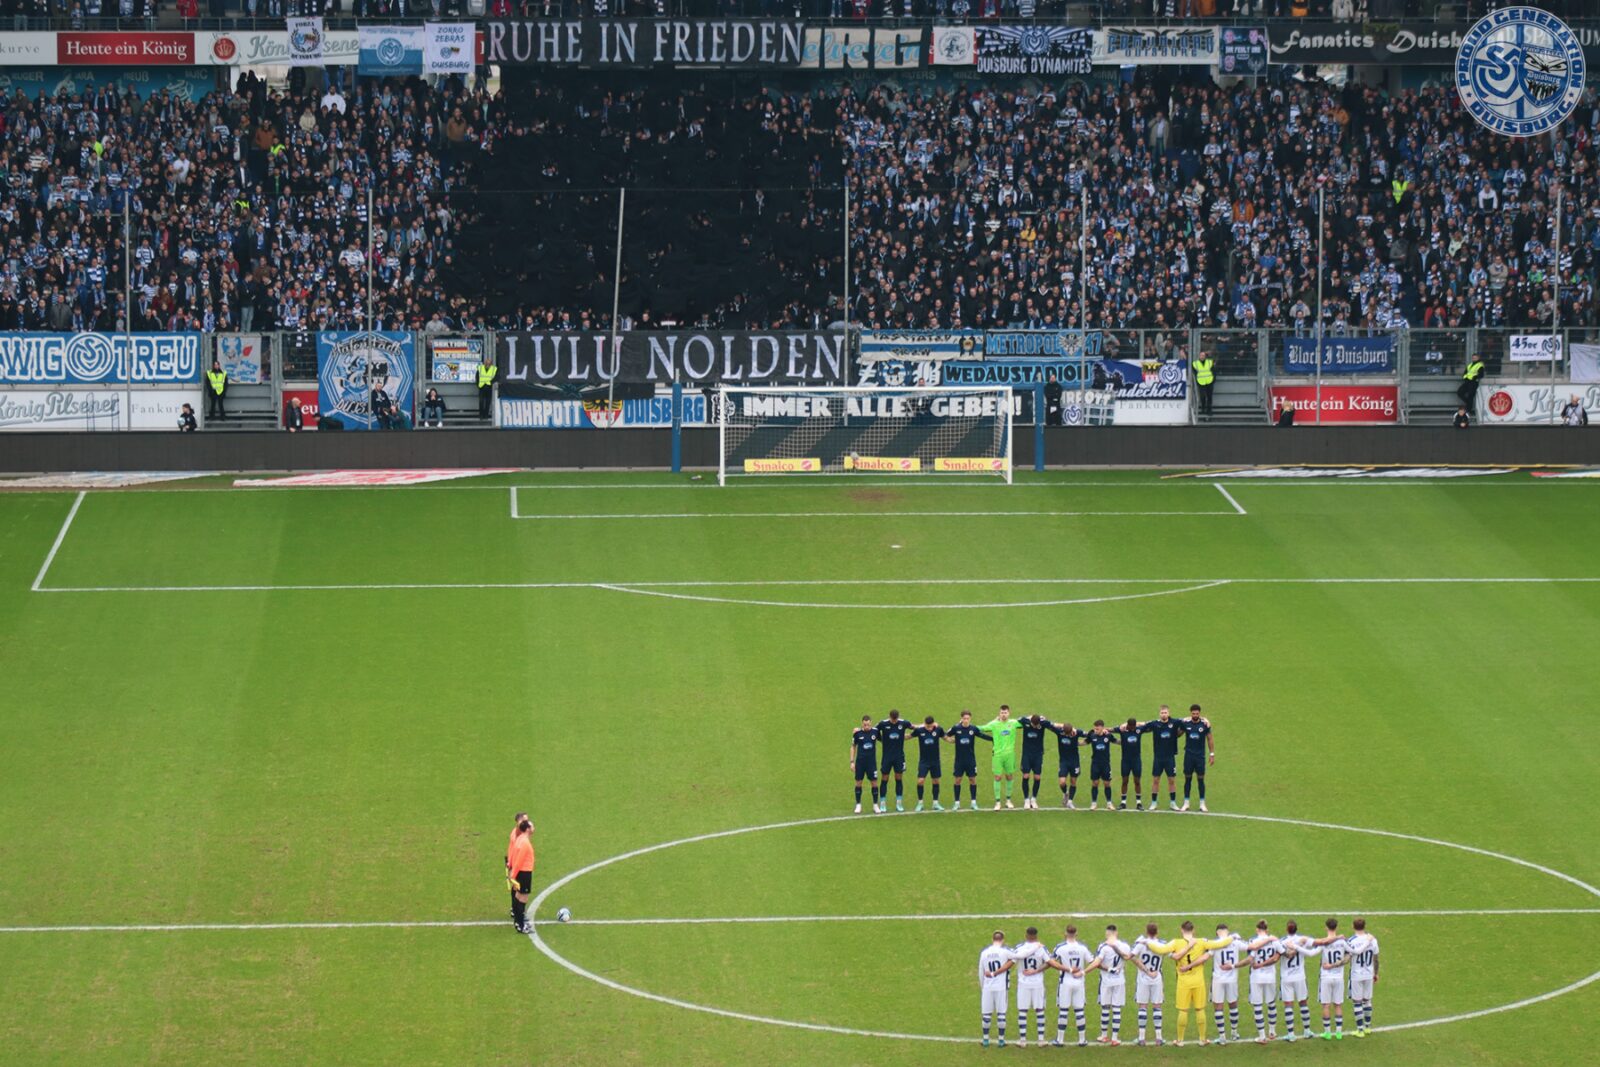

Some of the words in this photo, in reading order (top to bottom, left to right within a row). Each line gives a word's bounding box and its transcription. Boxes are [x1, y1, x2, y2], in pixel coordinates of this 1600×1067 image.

[434, 35, 465, 43] ZEBRAS
[438, 26, 463, 34] ZORRO
[65, 41, 112, 56] Heute
[115, 42, 138, 56] ein
[142, 41, 188, 61] König
[487, 21, 582, 62] RUHE
[599, 22, 638, 62] IN
[653, 20, 804, 62] FRIEDEN
[1270, 30, 1375, 54] Fanatics
[431, 61, 470, 69] DUISBURG
[977, 58, 1028, 74] DUISBURG
[1030, 58, 1092, 74] DYNAMITES
[0, 337, 67, 380] WIG
[112, 335, 198, 380] TREU
[504, 335, 624, 380] LULU
[646, 335, 845, 380] NOLDEN
[1335, 345, 1389, 368] Duisburg
[944, 363, 1089, 384] WEDAUSTADION
[44, 391, 120, 416] Pilsener
[502, 399, 582, 427] RUHRPOTT
[624, 395, 706, 425] DUISBRG
[742, 396, 833, 418] IMMER
[1272, 395, 1317, 411] Hute
[1320, 396, 1347, 411] ein
[1348, 394, 1394, 416] König
[752, 460, 795, 472] Sinalco
[852, 460, 894, 471] Sinalco
[942, 460, 985, 472] Sinalco
[1141, 953, 1161, 973] 29
[1220, 950, 1235, 967] 15
[1356, 948, 1374, 967] 40
